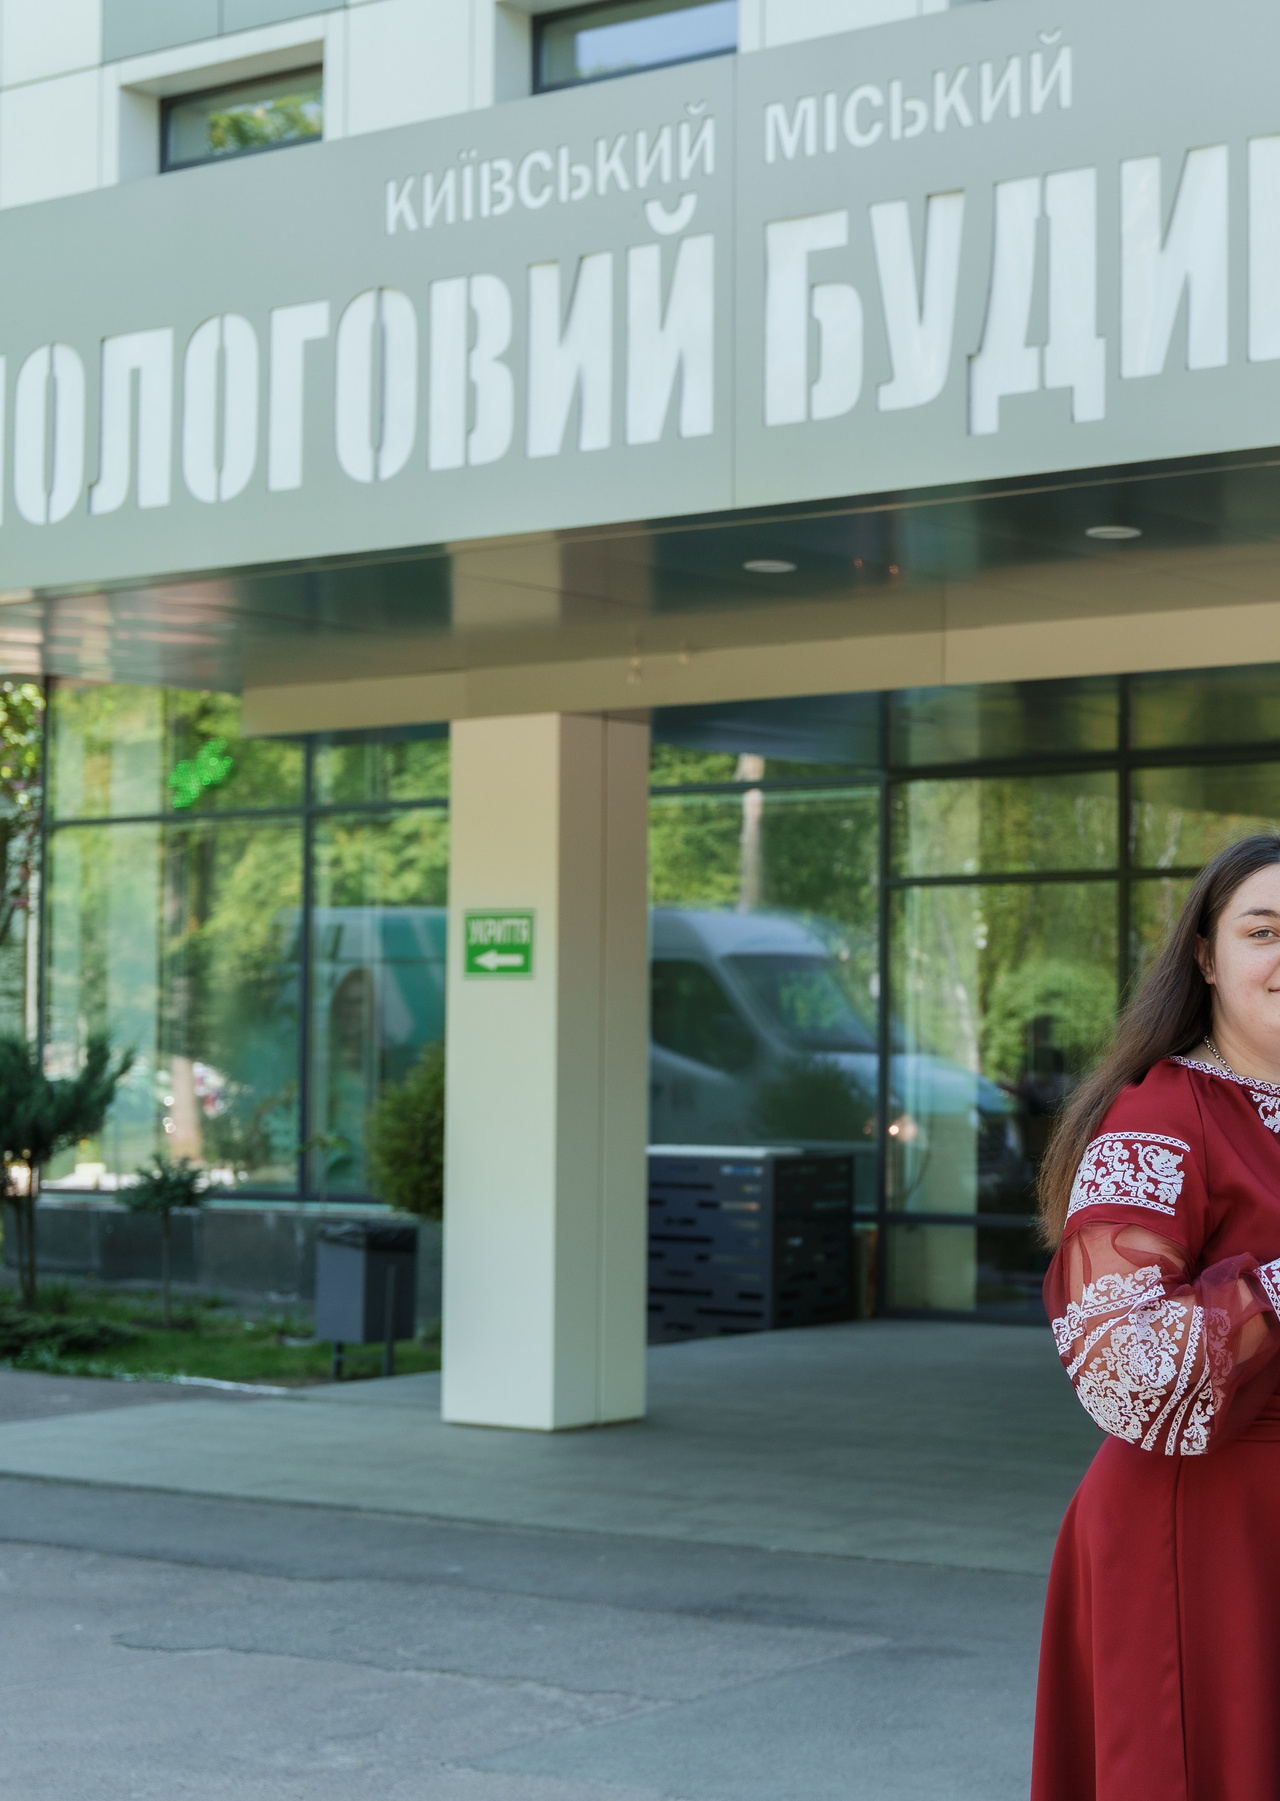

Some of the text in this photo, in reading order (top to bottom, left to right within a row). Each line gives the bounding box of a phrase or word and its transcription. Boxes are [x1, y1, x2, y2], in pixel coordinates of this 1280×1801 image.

[384, 31, 1074, 236] КИЇВСЬКИЙ МІСЬКИЙ
[0, 194, 715, 526] ОЛОГОВИЙ
